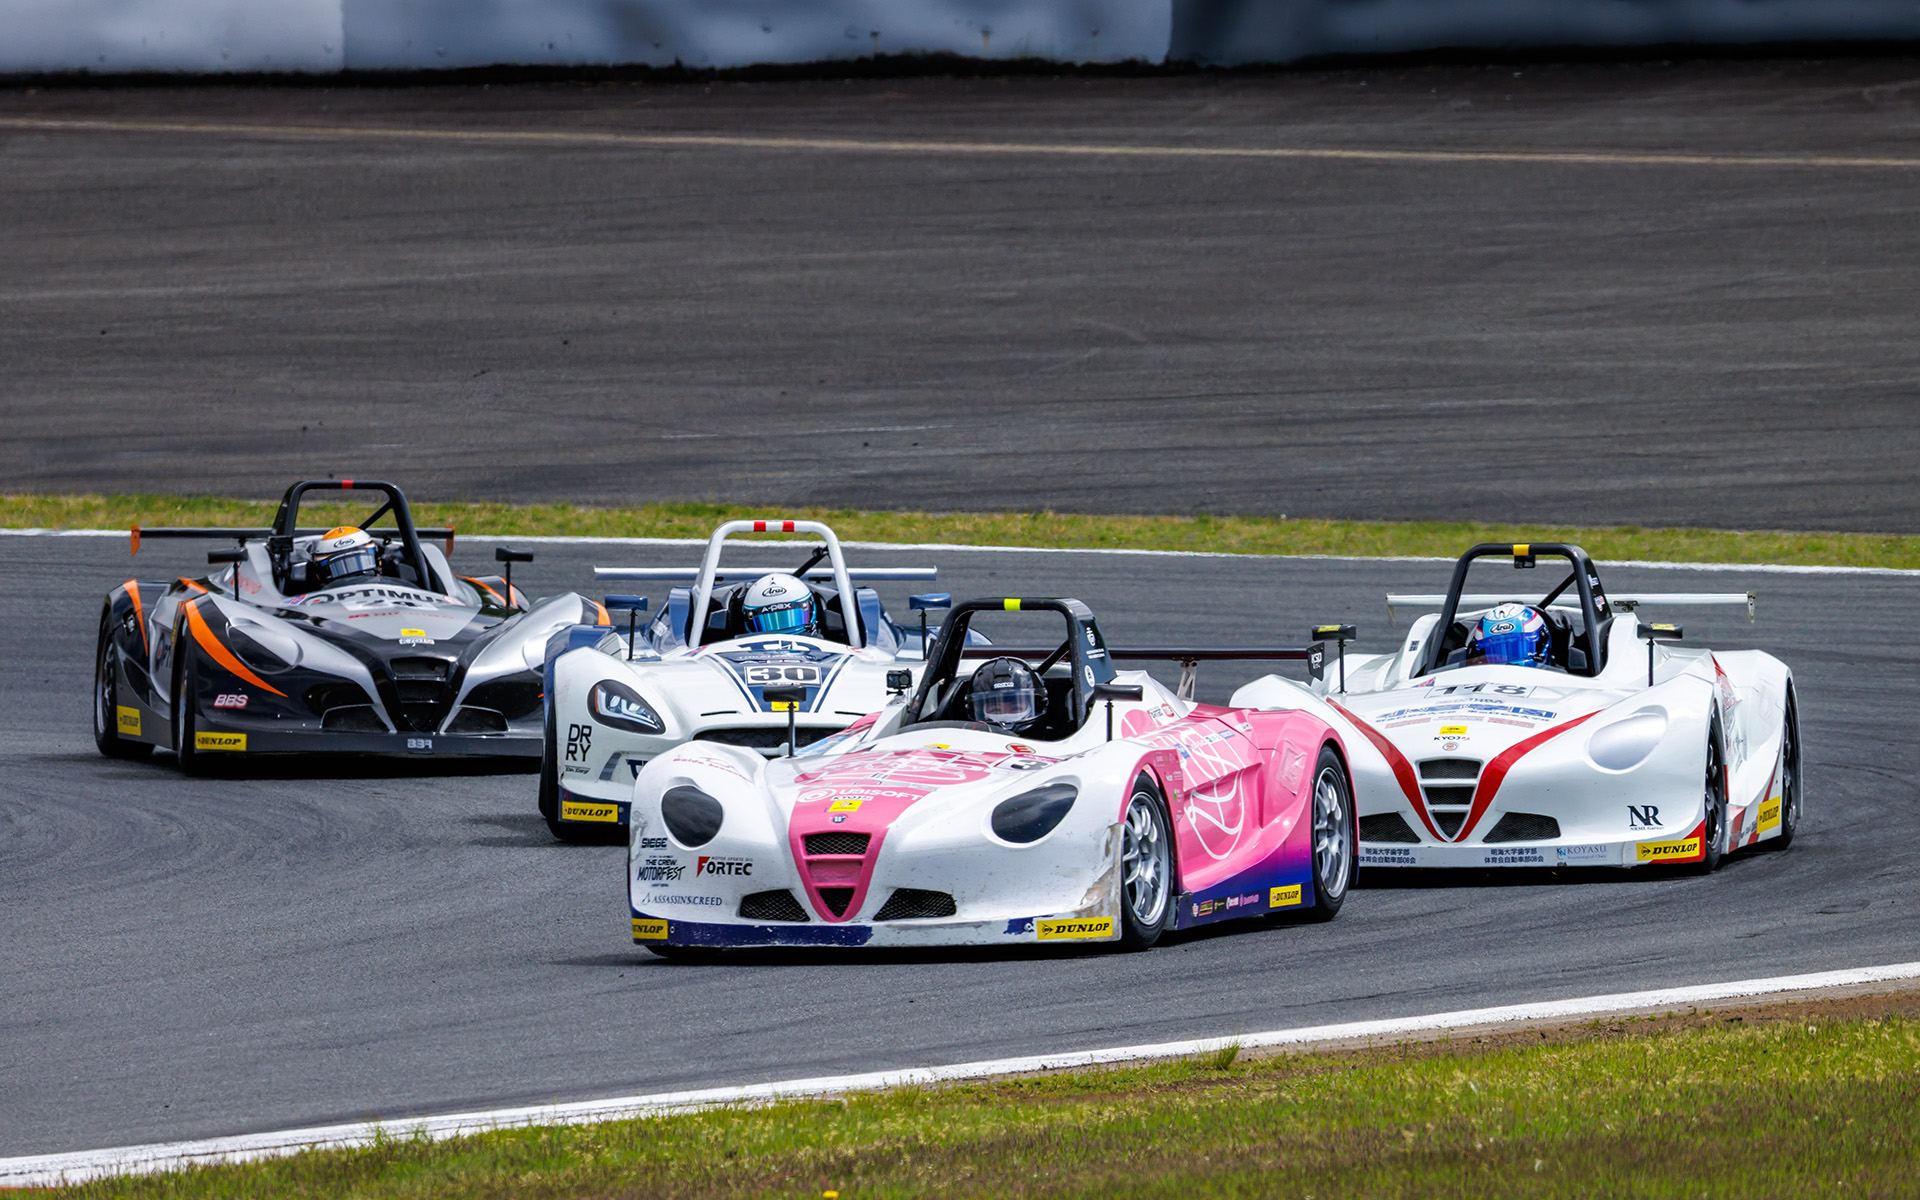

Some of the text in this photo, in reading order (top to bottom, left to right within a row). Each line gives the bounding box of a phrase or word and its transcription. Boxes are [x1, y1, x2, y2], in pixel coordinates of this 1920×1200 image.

[749, 667, 817, 681] 30
[1435, 682, 1526, 695] 118
[214, 694, 248, 708] BBS
[568, 723, 592, 744] DR
[200, 737, 241, 746] DUNLOP
[565, 742, 592, 762] RY
[839, 788, 924, 801] UBISOFT
[567, 807, 613, 817] DUNLOP
[1627, 805, 1664, 826] NR
[1762, 805, 1779, 822] DUNLOP
[641, 837, 668, 848] SIEGE
[1652, 843, 1698, 855] DUNLOP
[1567, 845, 1607, 854] KOYASU
[637, 865, 686, 880] MOTORFEST
[697, 856, 753, 877] FORTEC
[693, 896, 723, 906] CREED
[1276, 890, 1300, 902] DUNLOP
[1054, 922, 1110, 934] DUNLOP
